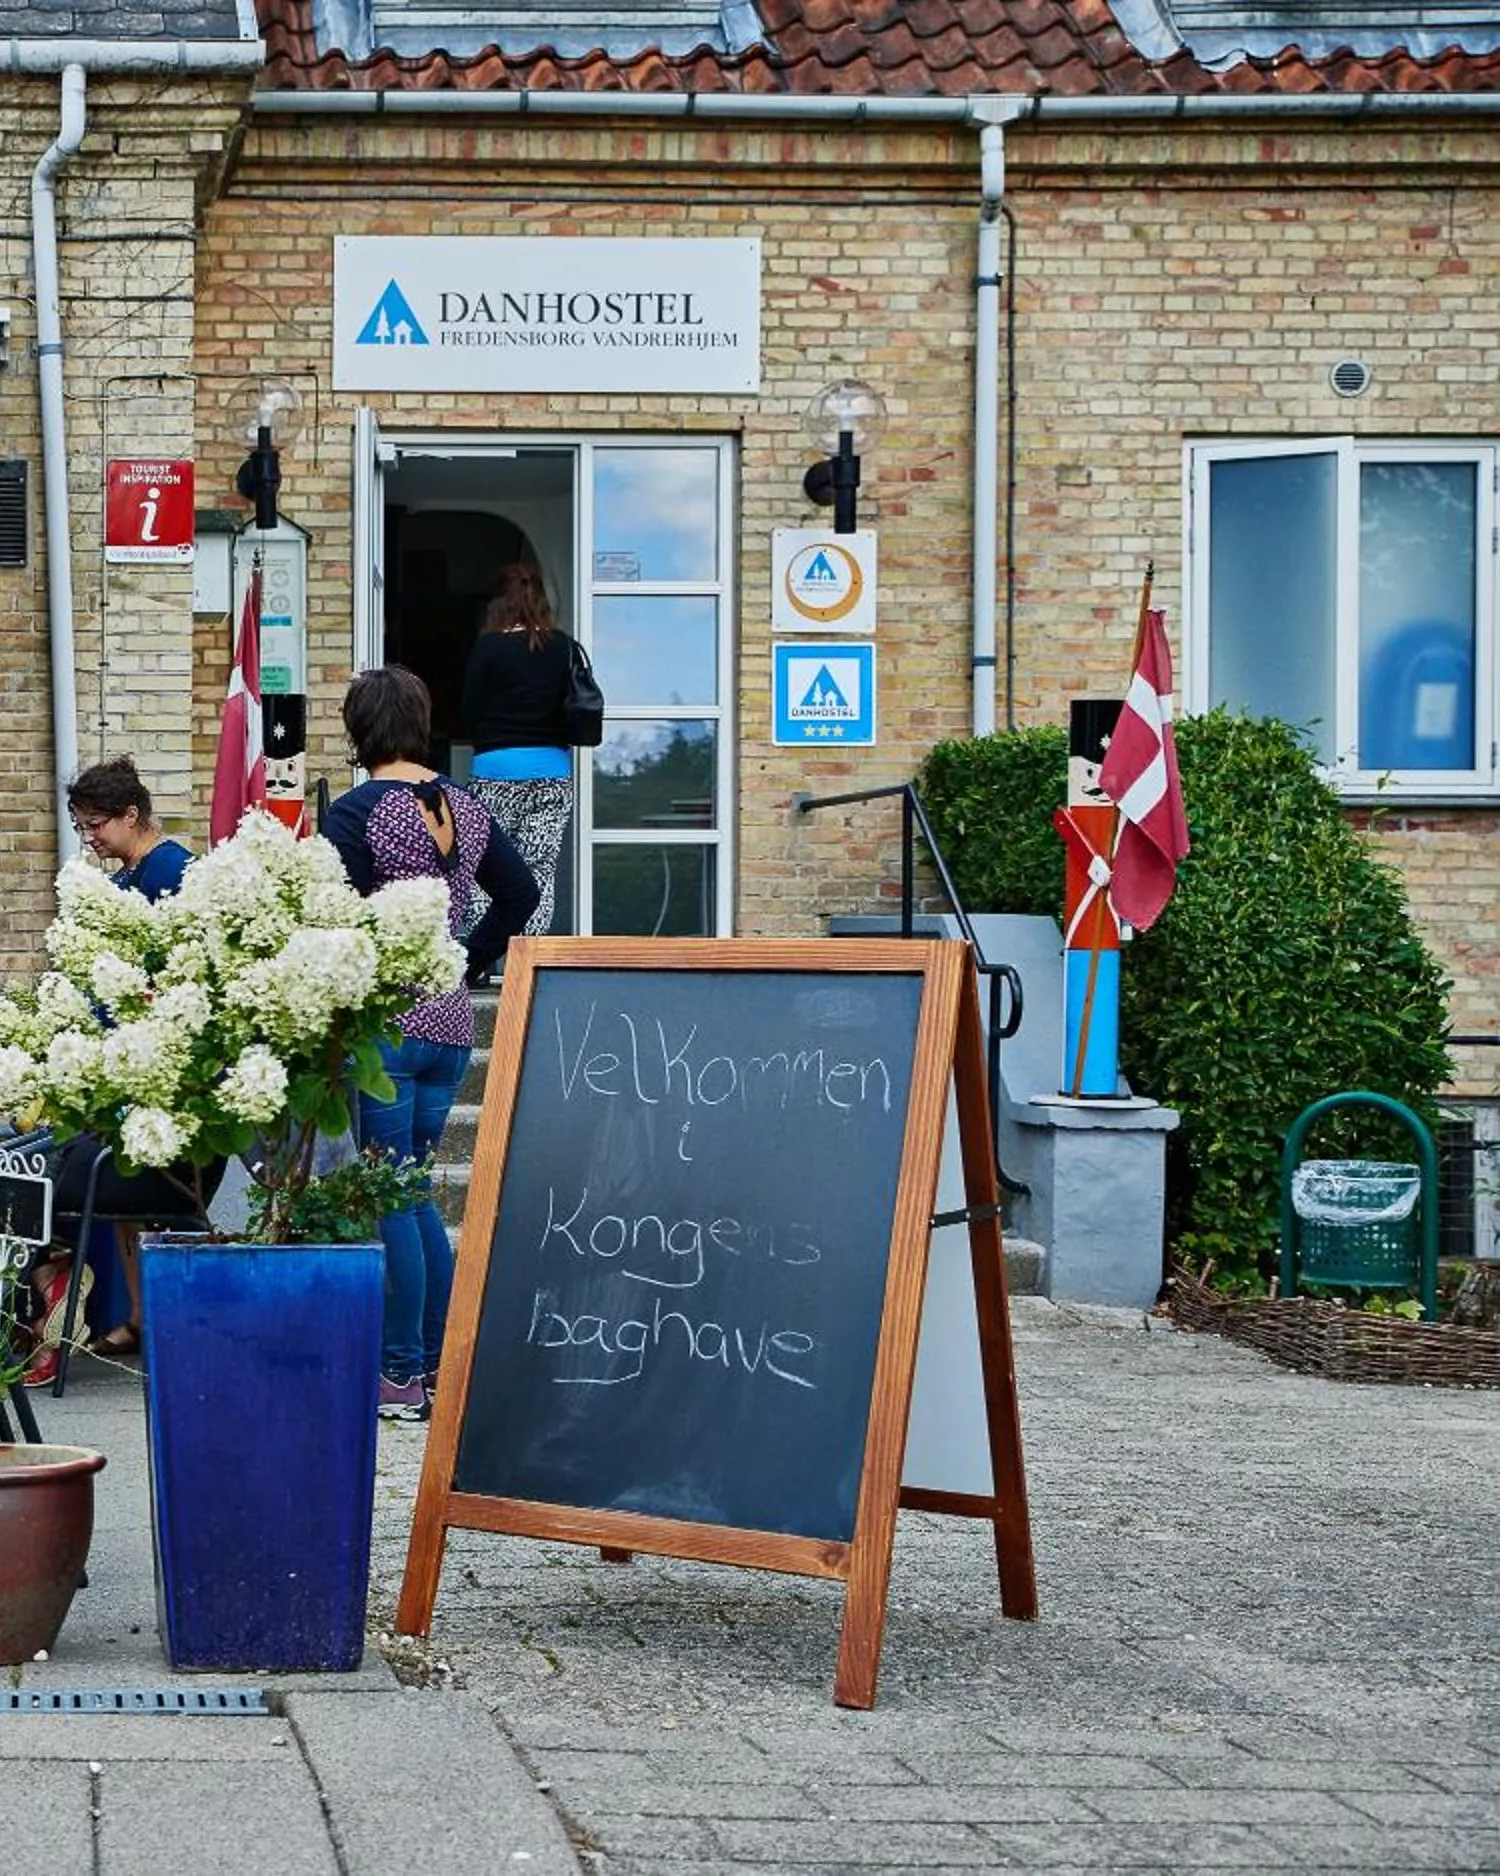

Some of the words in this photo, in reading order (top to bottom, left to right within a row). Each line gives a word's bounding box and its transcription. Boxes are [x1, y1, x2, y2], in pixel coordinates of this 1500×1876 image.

[438, 292, 703, 325] DANHOSTEL
[440, 330, 586, 348] FREDENSBORG
[593, 330, 738, 350] VANDRERHJEM
[119, 474, 181, 484] INSPIRATION
[130, 464, 171, 474] TOURIST
[791, 707, 856, 717] DANHOSTEL
[677, 1120, 693, 1161] i
[526, 1294, 817, 1390] baghave
